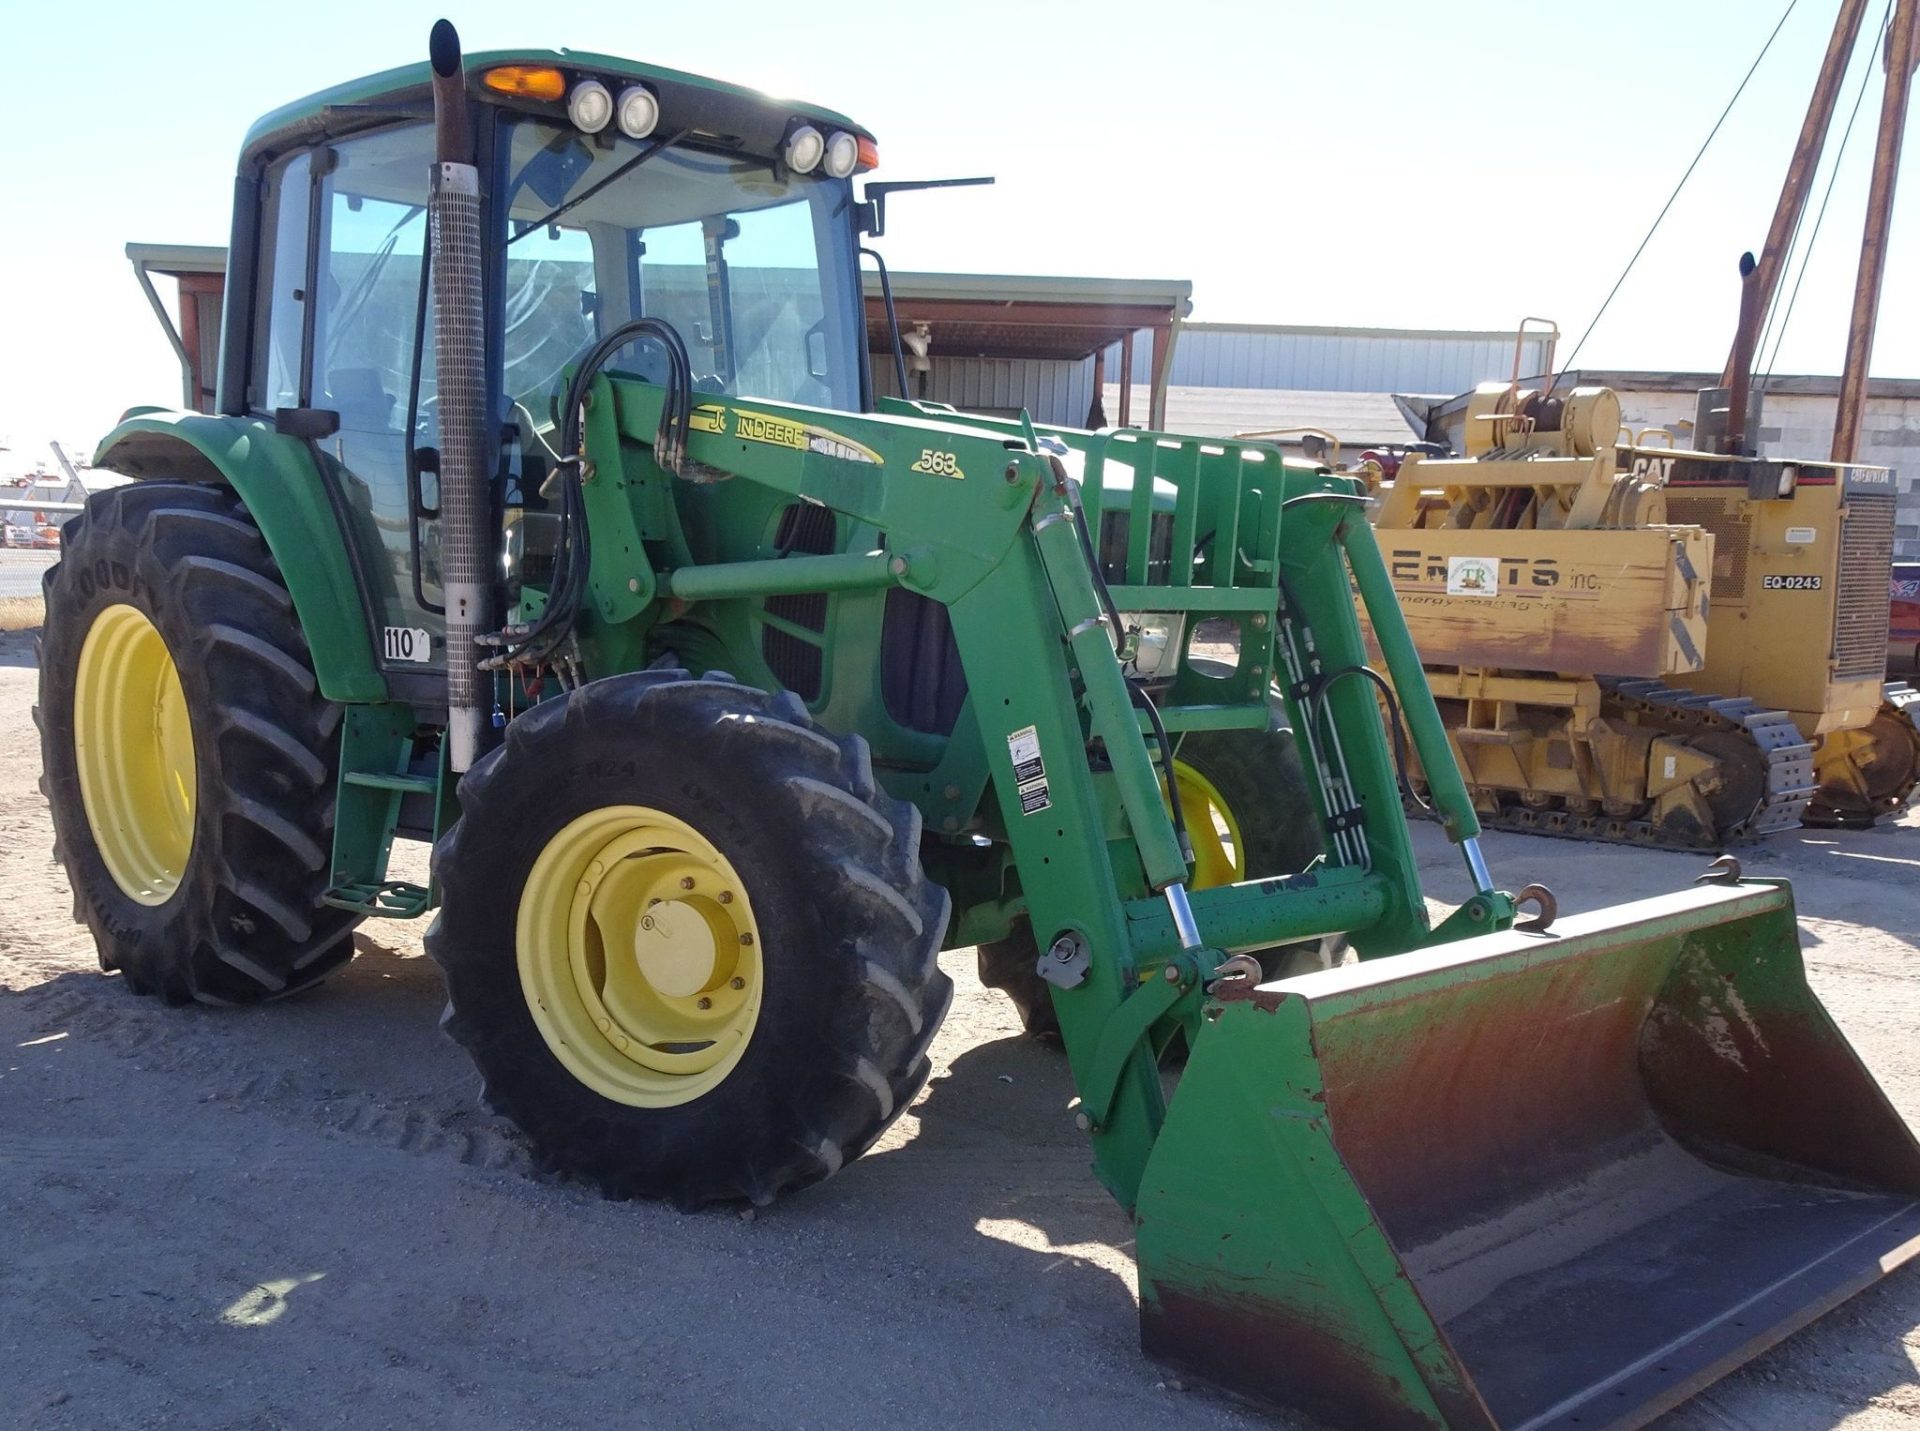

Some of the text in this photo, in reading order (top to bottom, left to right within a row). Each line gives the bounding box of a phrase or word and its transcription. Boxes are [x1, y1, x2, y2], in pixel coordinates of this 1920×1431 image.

[753, 417, 805, 446] DEERE
[921, 449, 956, 475] 563
[1632, 457, 1676, 485] CAT
[1763, 576, 1821, 589] EQ-0243
[1398, 595, 1454, 608] nergy
[387, 629, 413, 657] 110
